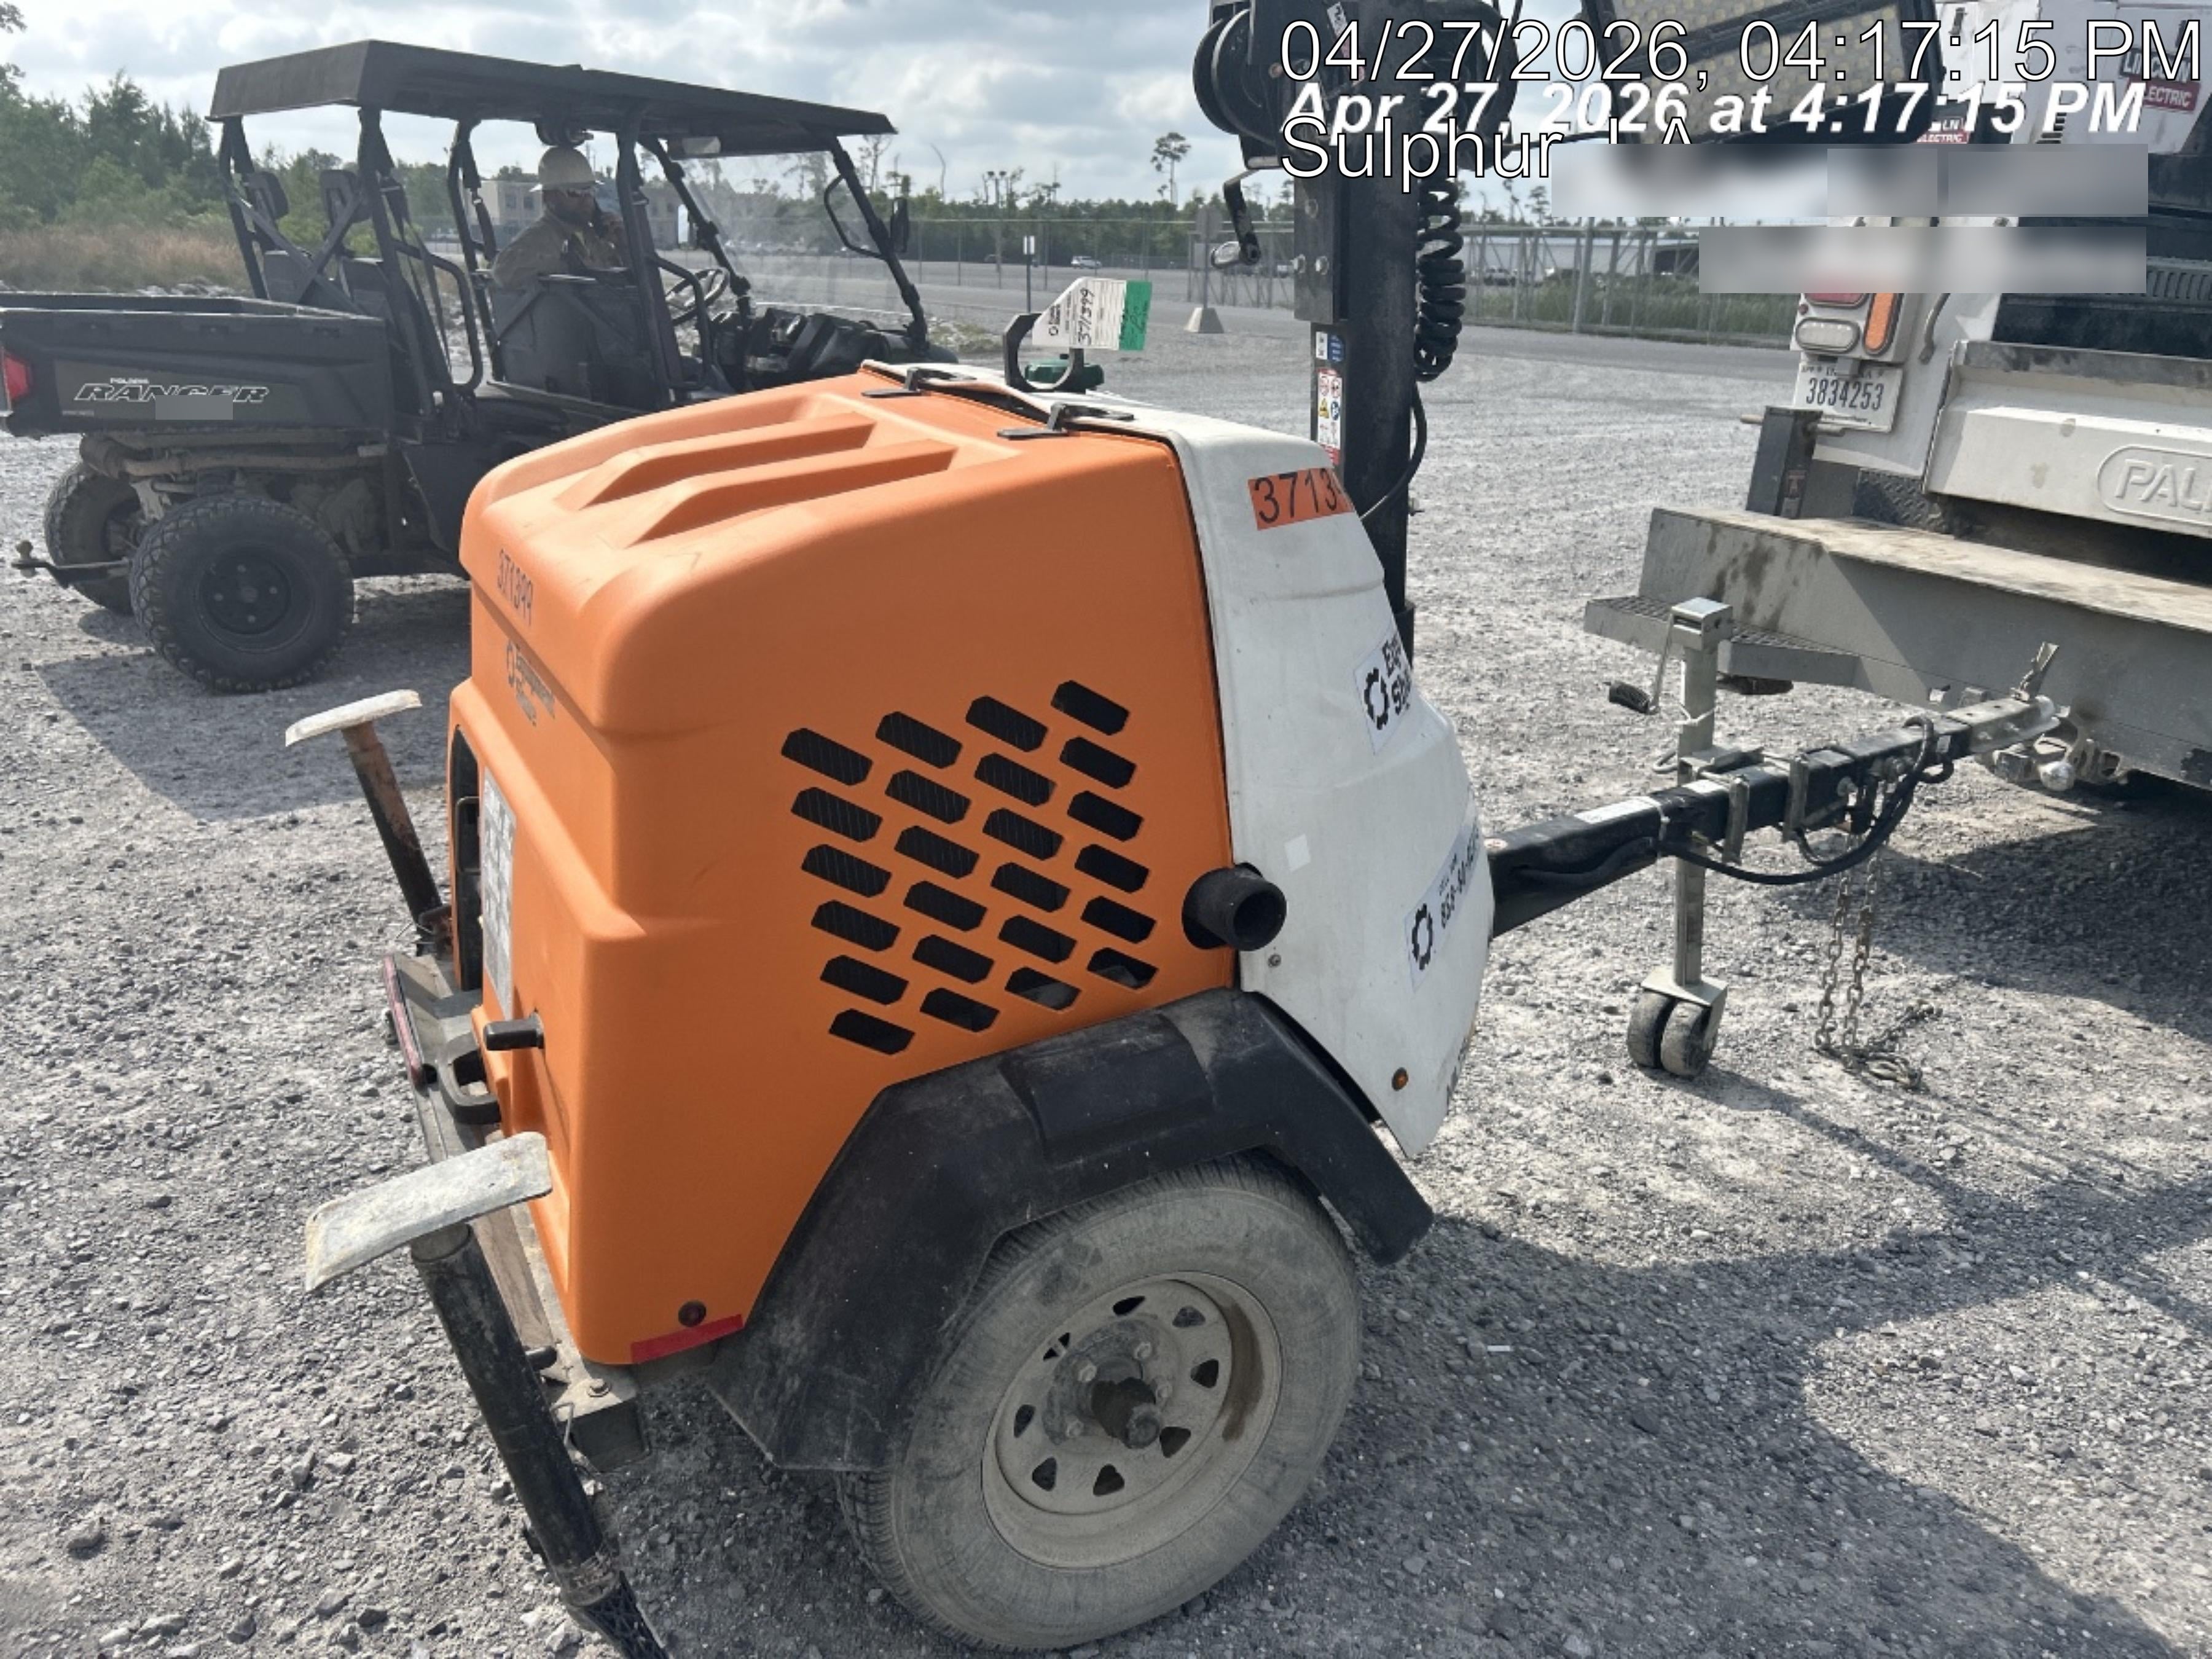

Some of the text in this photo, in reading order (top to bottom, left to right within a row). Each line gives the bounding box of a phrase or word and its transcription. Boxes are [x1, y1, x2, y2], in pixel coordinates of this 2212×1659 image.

[1806, 377, 1885, 410] 3834253
[1255, 468, 1342, 524] 3713
[2114, 458, 2212, 513] PAL
